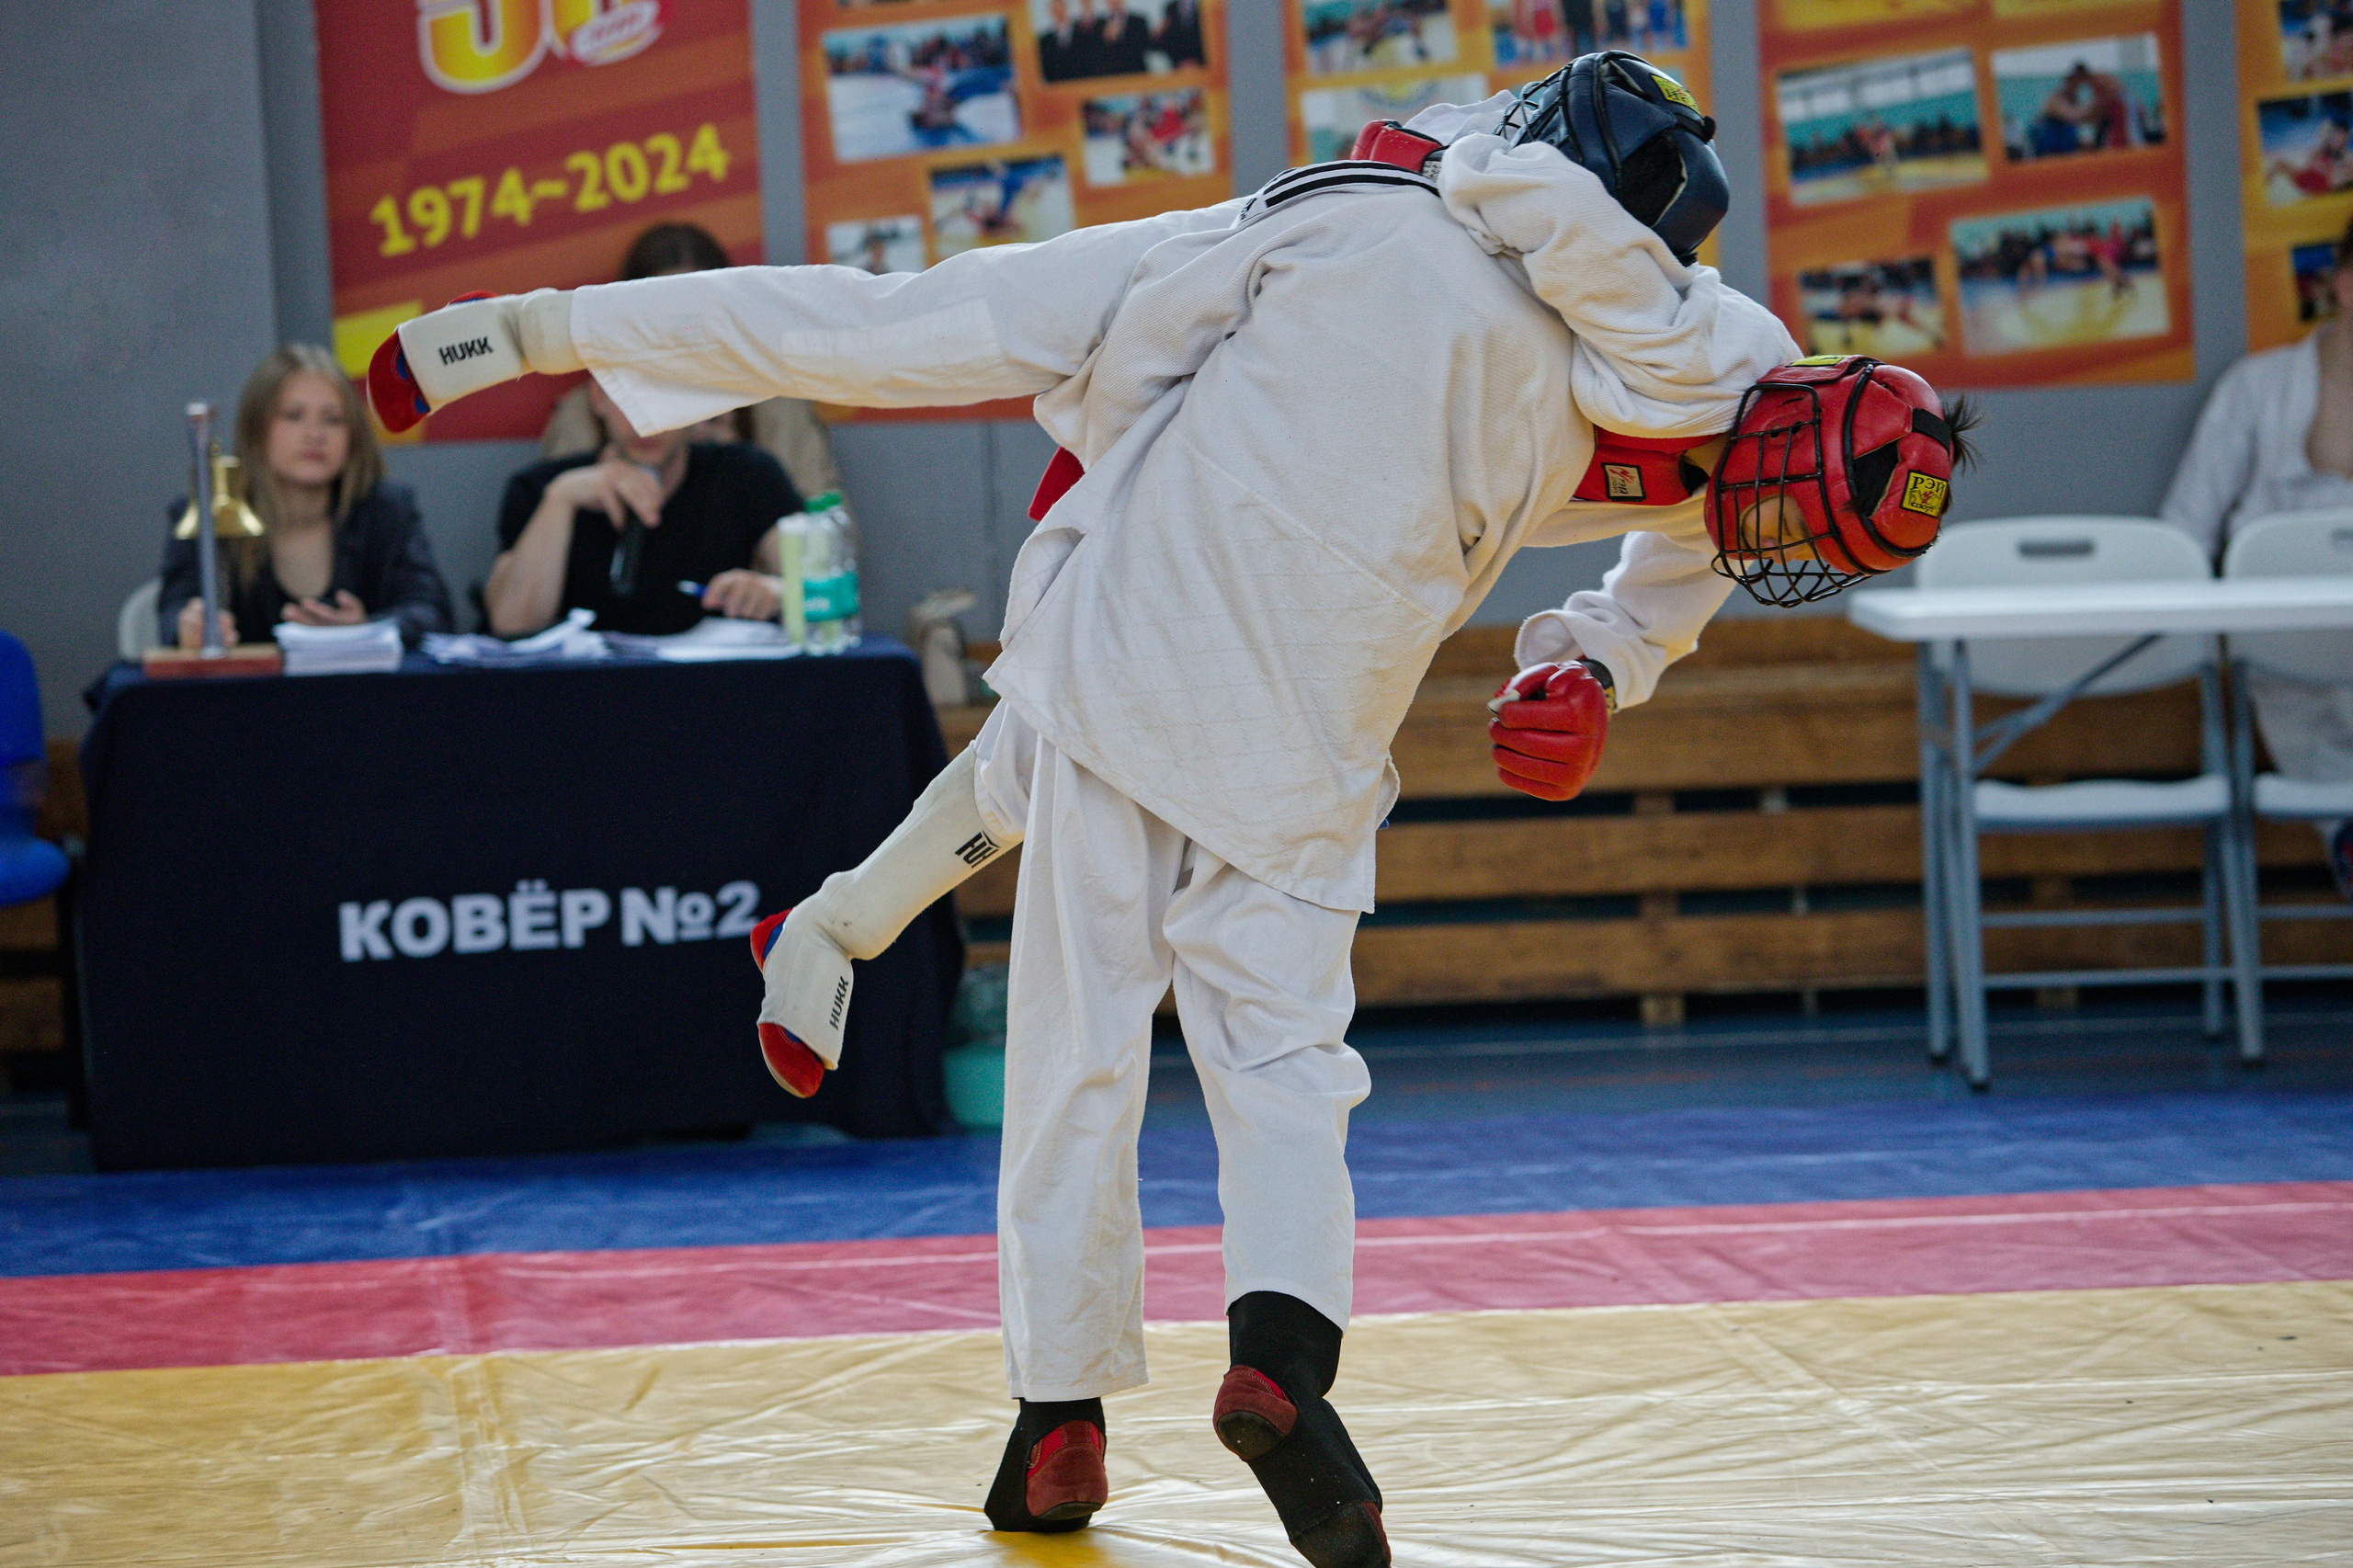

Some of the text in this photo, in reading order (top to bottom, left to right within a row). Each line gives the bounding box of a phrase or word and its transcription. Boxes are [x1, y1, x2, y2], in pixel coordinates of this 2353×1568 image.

[438, 336, 494, 366] HUKK
[337, 878, 612, 963] КОВЁР
[829, 975, 849, 1031] HUKK
